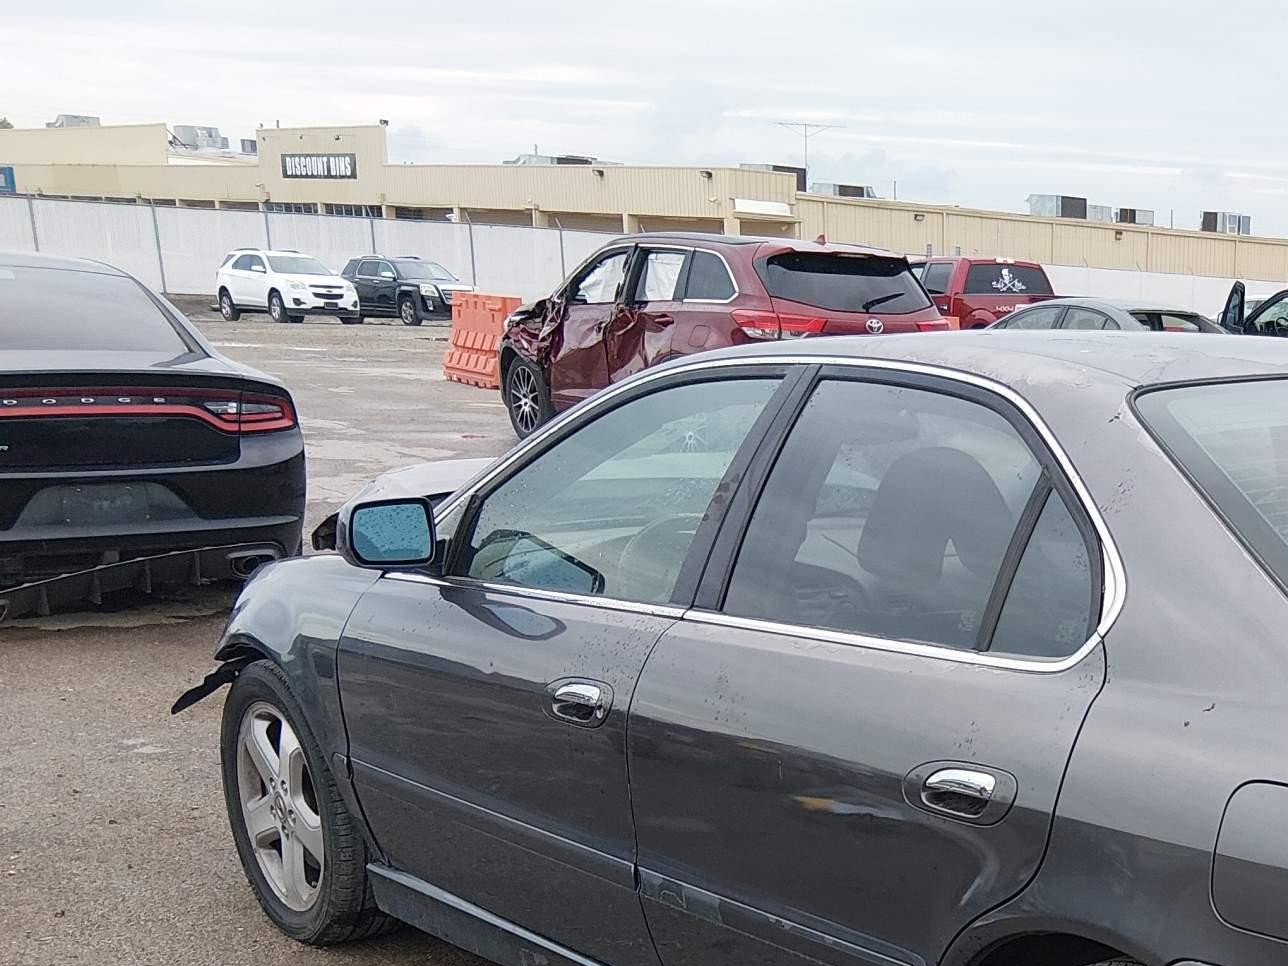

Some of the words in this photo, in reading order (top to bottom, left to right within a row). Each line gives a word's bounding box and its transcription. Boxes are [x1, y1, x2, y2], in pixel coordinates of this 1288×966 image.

[285, 156, 328, 176] DISCOUNT
[329, 156, 352, 176] BINS
[3, 397, 166, 406] DODGE
